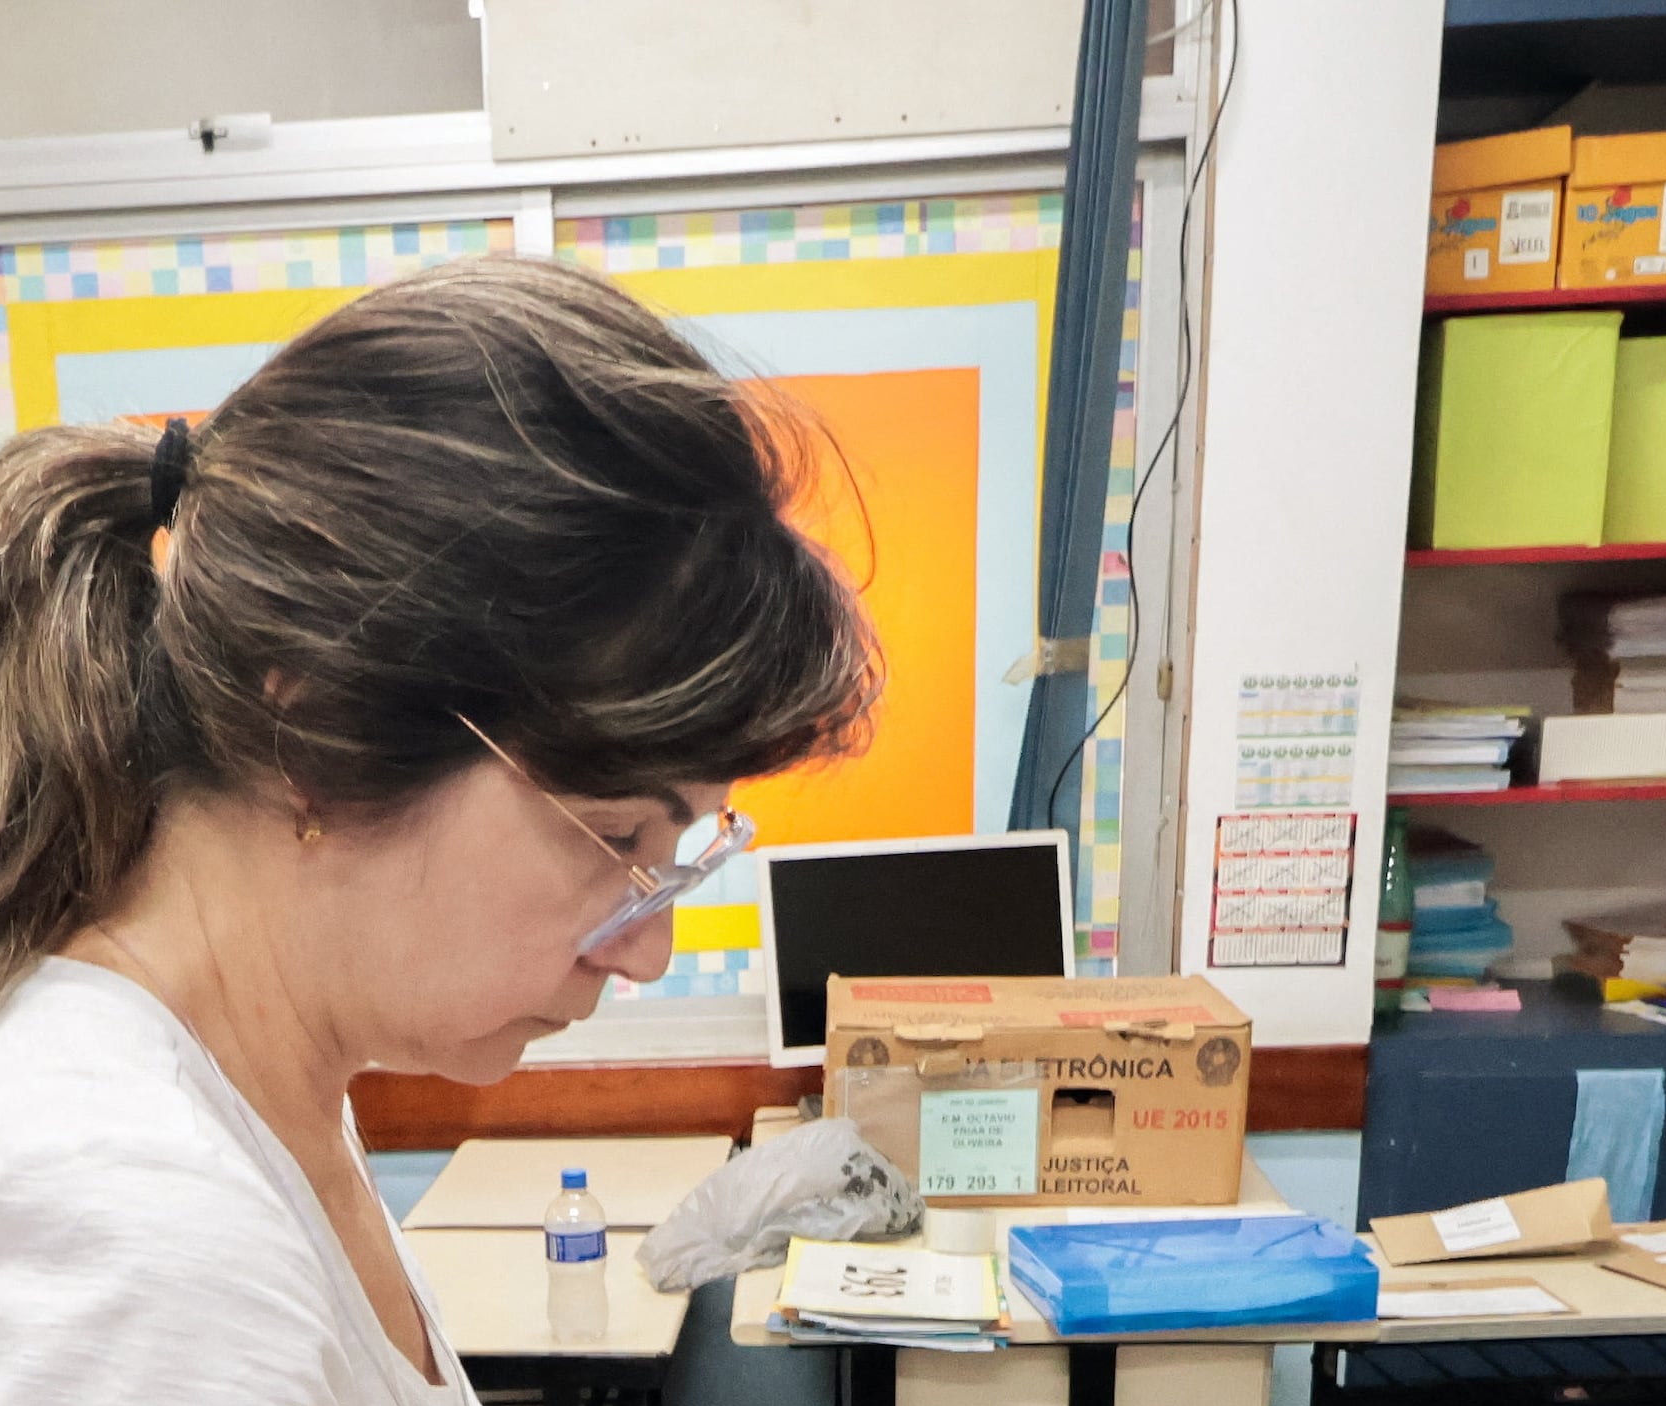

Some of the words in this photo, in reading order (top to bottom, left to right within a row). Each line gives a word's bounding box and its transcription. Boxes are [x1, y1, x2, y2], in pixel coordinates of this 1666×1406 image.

[1133, 1109, 1165, 1129] UE
[1173, 1109, 1228, 1129] 2015
[1043, 1156, 1130, 1175] JUSTIÇA
[1039, 1178, 1142, 1195] LEITORAL
